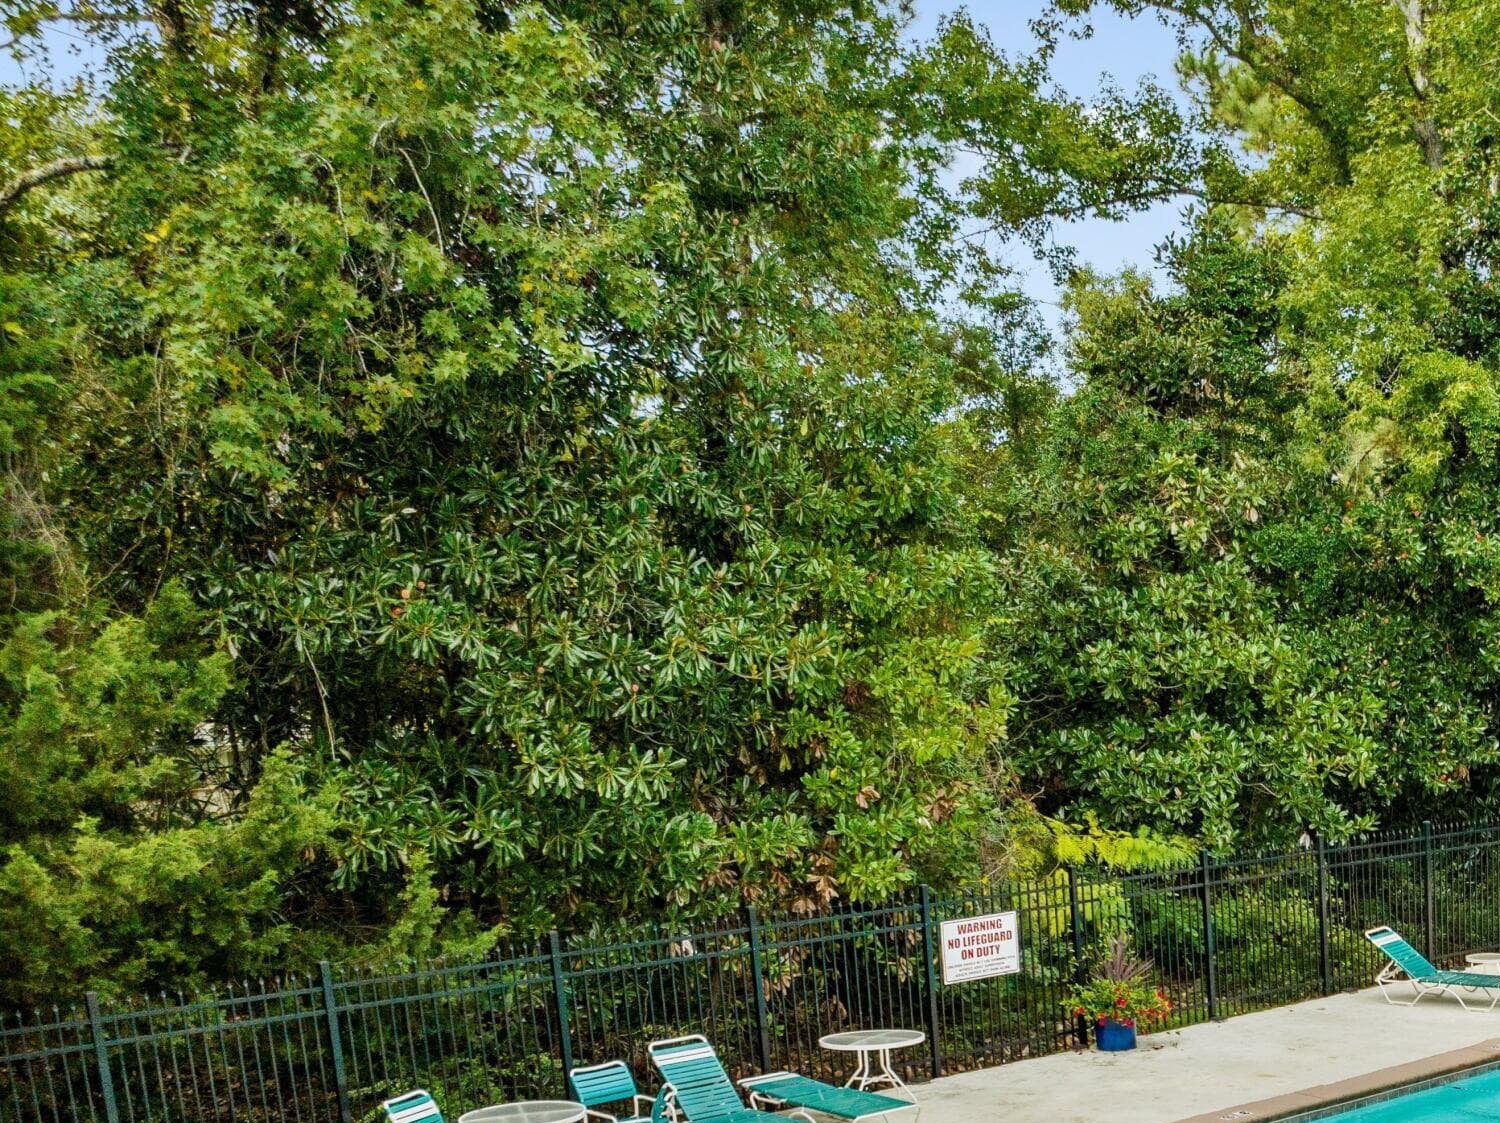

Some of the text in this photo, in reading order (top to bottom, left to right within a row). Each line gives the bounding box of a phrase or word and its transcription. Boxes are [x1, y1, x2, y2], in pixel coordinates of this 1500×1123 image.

[957, 919, 1002, 935] WARNING
[948, 930, 1012, 950] NO LIFEGUARD
[961, 944, 1001, 960] ON DUTY
